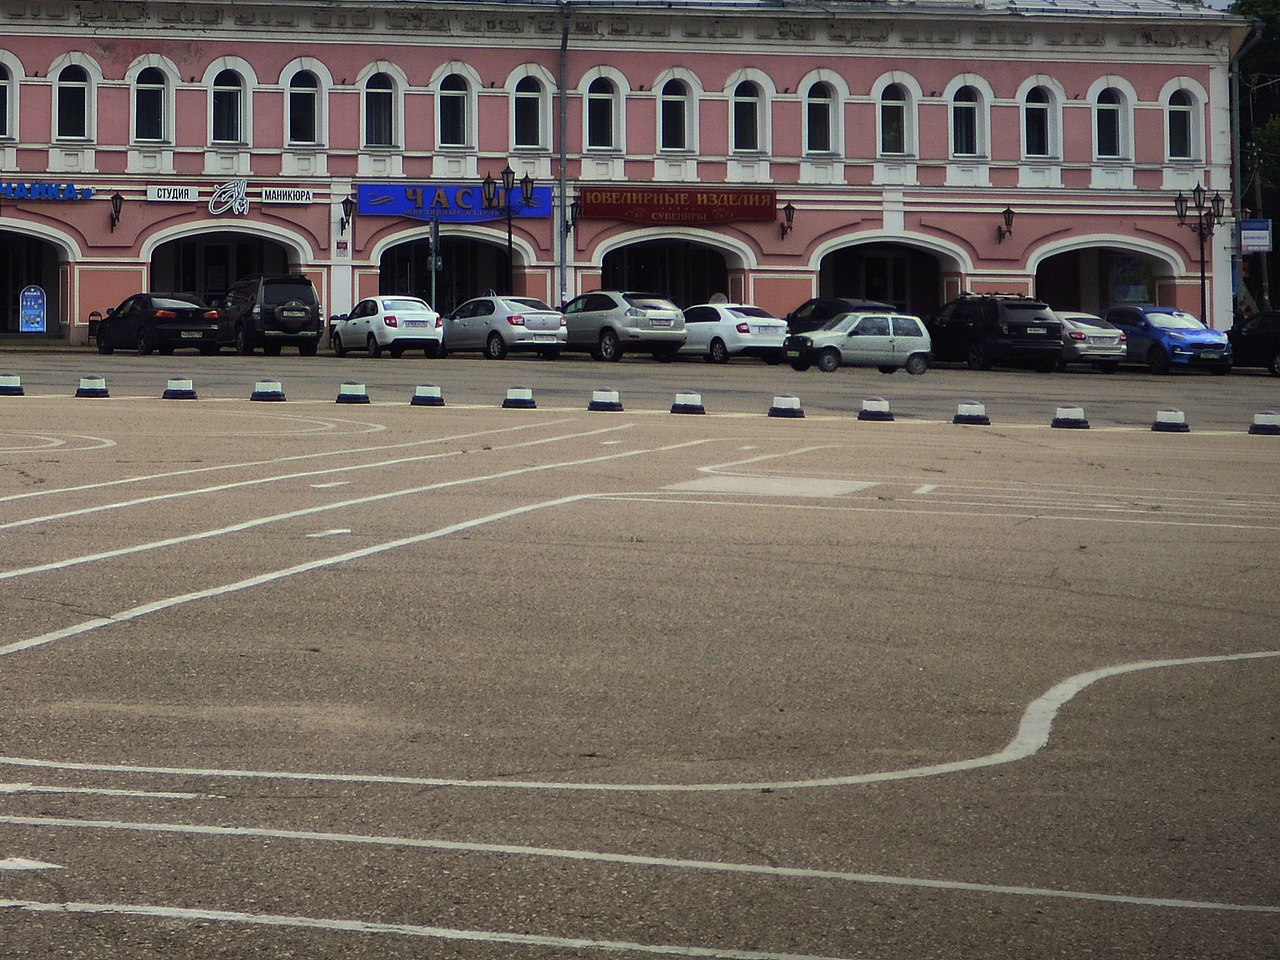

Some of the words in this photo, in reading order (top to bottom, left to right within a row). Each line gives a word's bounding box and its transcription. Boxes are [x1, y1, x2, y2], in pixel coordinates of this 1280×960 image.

[156, 188, 189, 200] СТУДИЯ
[264, 190, 311, 201] МАНИКЮРА
[405, 188, 507, 209] ЧАСЫ
[586, 192, 690, 205] ЮВЕЛИРНЫЕ
[697, 193, 771, 207] ИЗДЕЛИЯ
